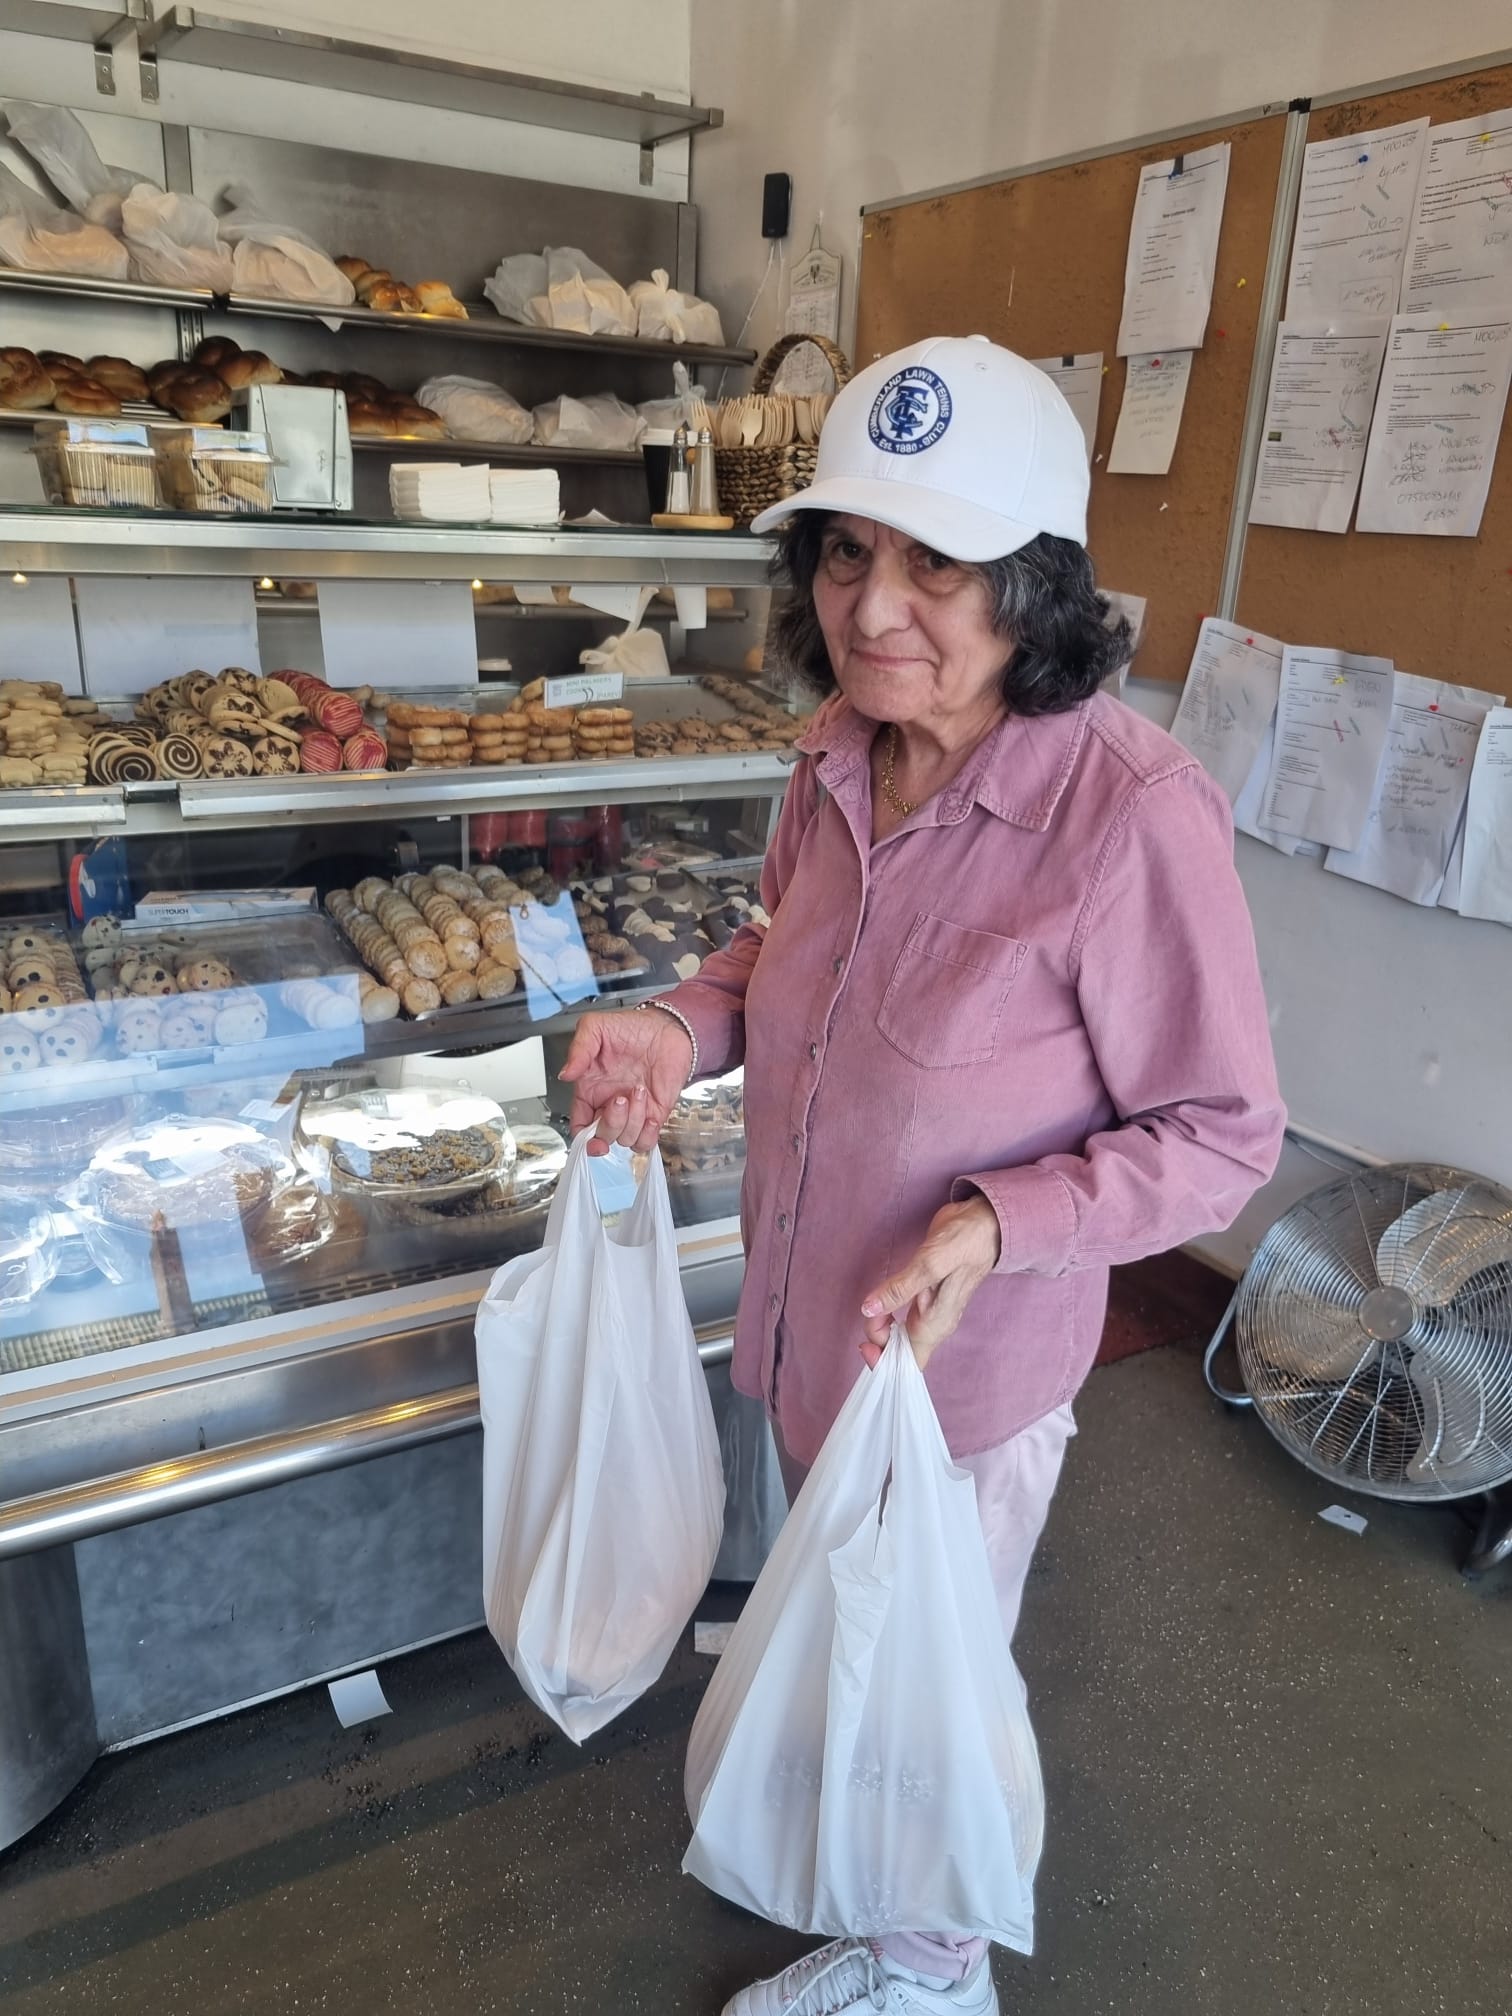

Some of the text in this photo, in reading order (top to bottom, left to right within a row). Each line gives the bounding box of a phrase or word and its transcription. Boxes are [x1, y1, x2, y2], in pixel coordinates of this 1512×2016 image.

[905, 369, 935, 384] LAWN
[934, 381, 951, 418] TENNIS
[922, 421, 945, 446] CLUB
[895, 443, 917, 453] 1880
